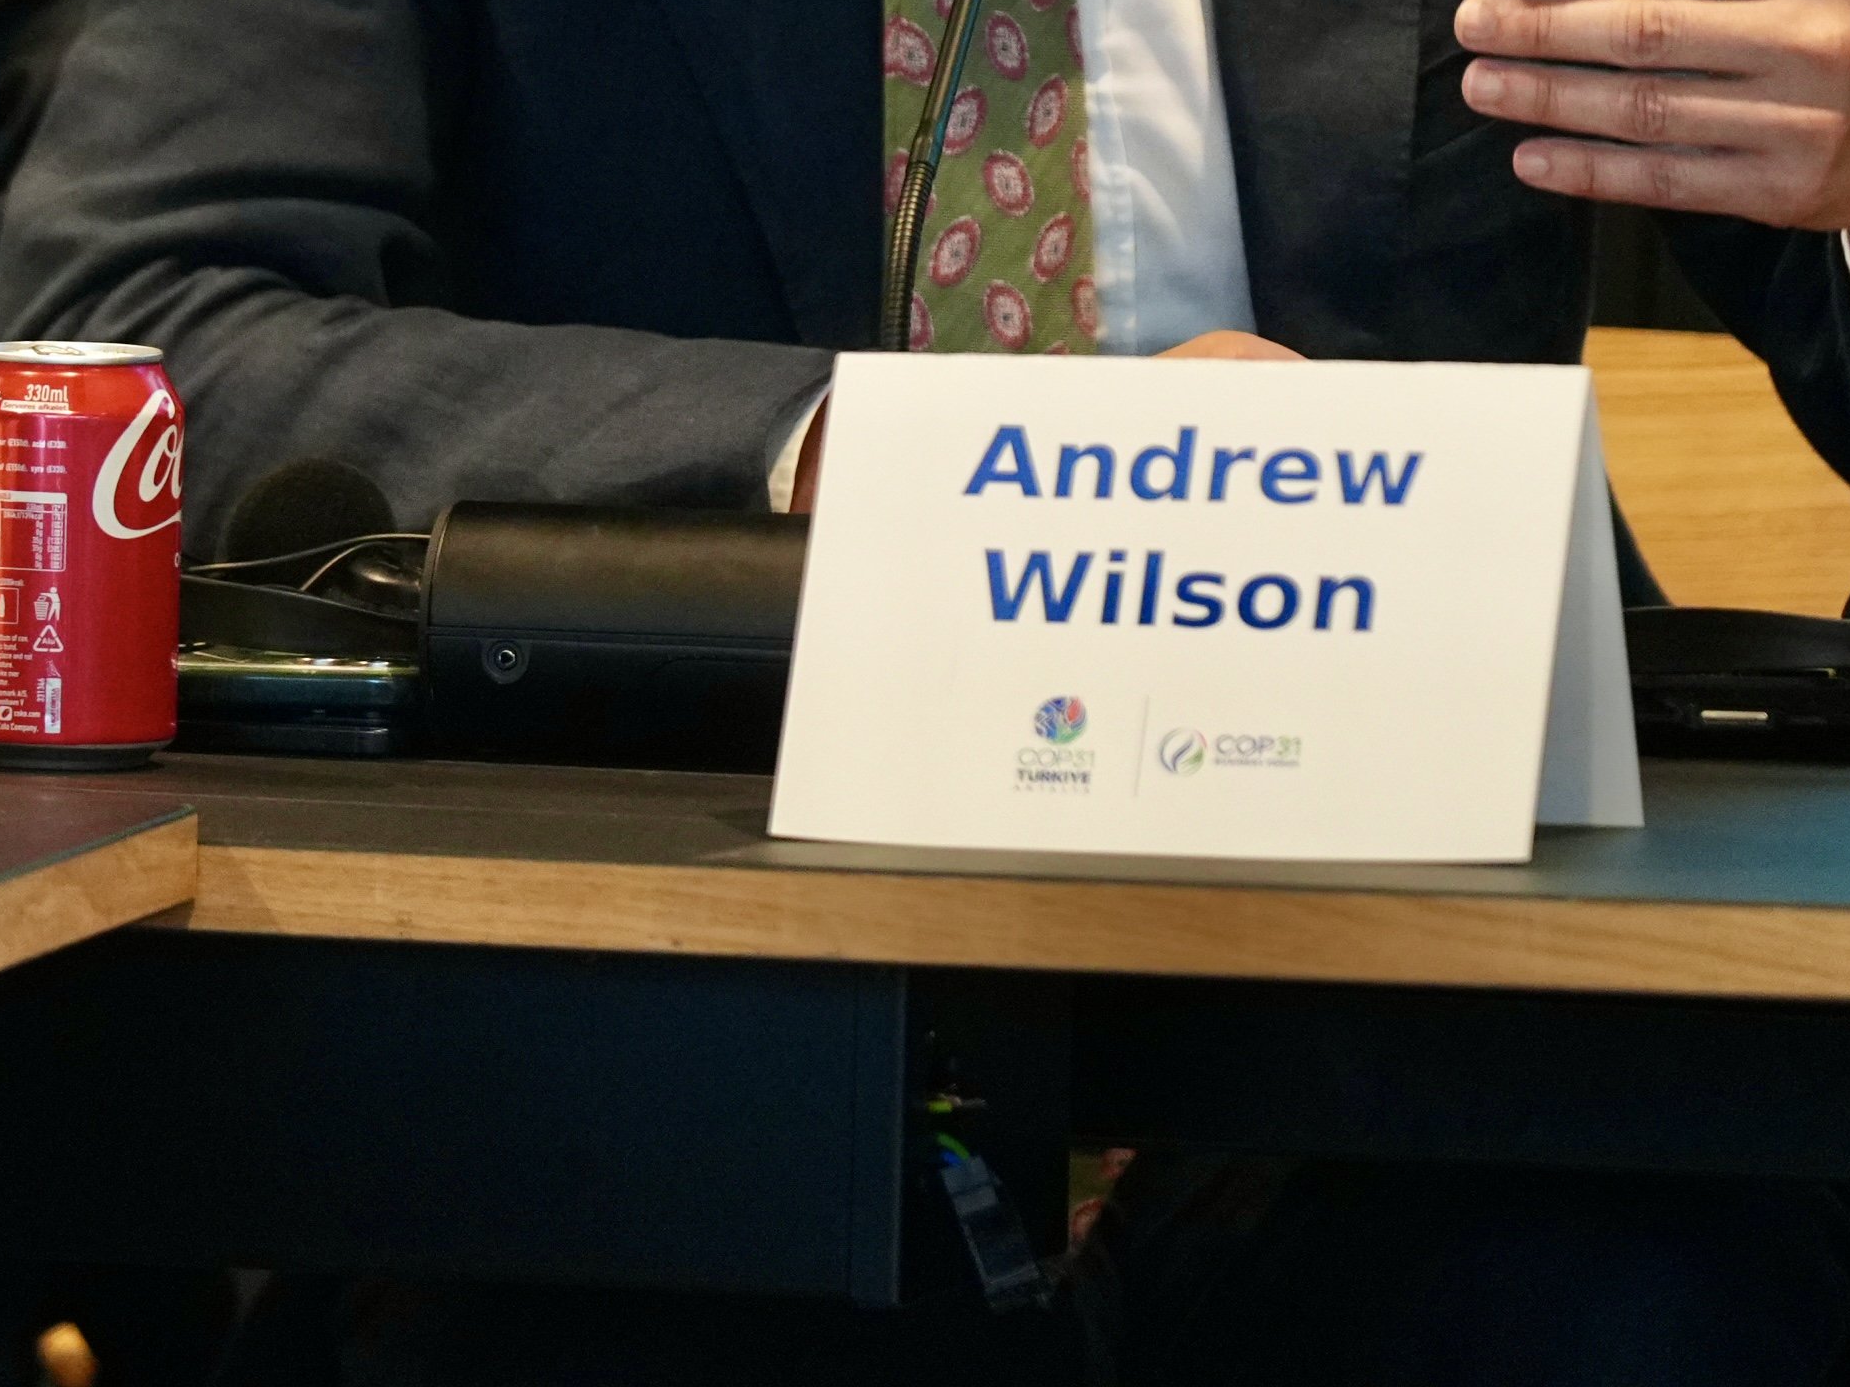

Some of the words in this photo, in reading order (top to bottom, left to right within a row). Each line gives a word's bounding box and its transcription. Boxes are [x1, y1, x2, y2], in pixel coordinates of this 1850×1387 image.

[24, 383, 69, 403] 330ml
[963, 425, 1423, 507] Andrew
[985, 549, 1376, 632] Wilson
